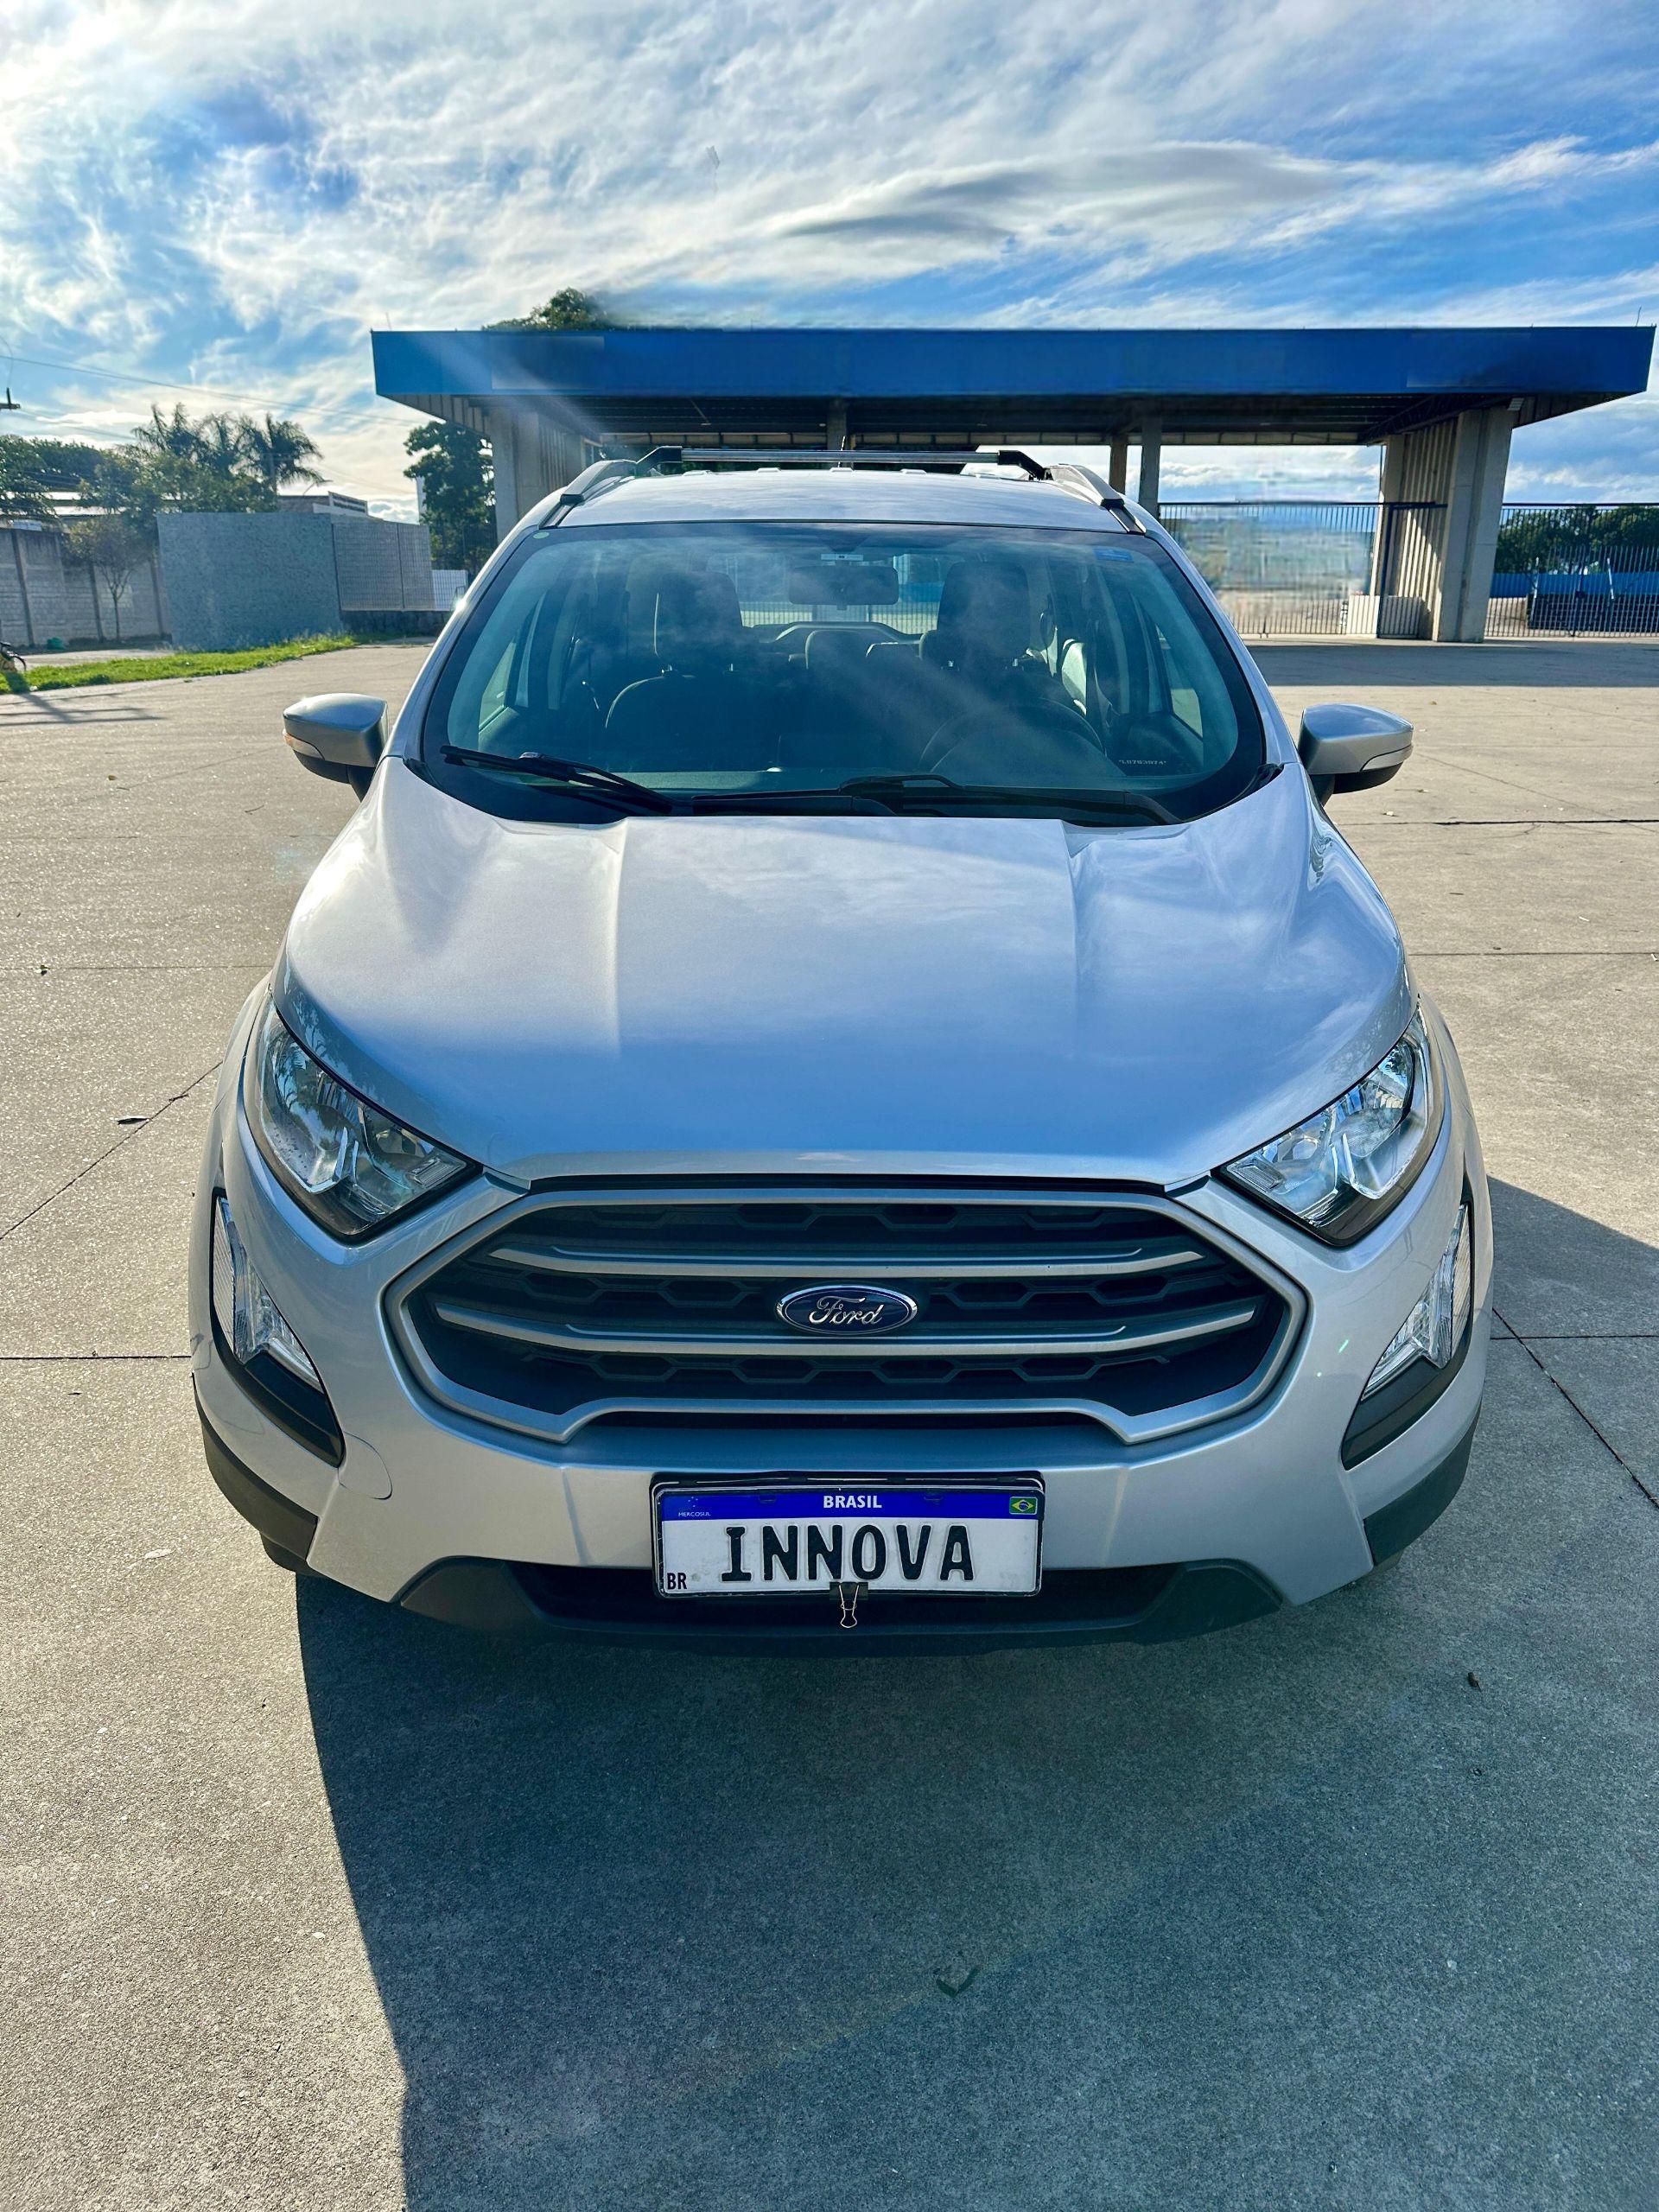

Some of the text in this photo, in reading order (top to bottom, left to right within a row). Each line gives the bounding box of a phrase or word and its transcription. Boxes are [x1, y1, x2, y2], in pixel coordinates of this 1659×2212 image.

[809, 1295, 885, 1325] Ford
[823, 1495, 882, 1509] BRASIL
[721, 1525, 974, 1581] INNOVA
[666, 1572, 688, 1591] BR
